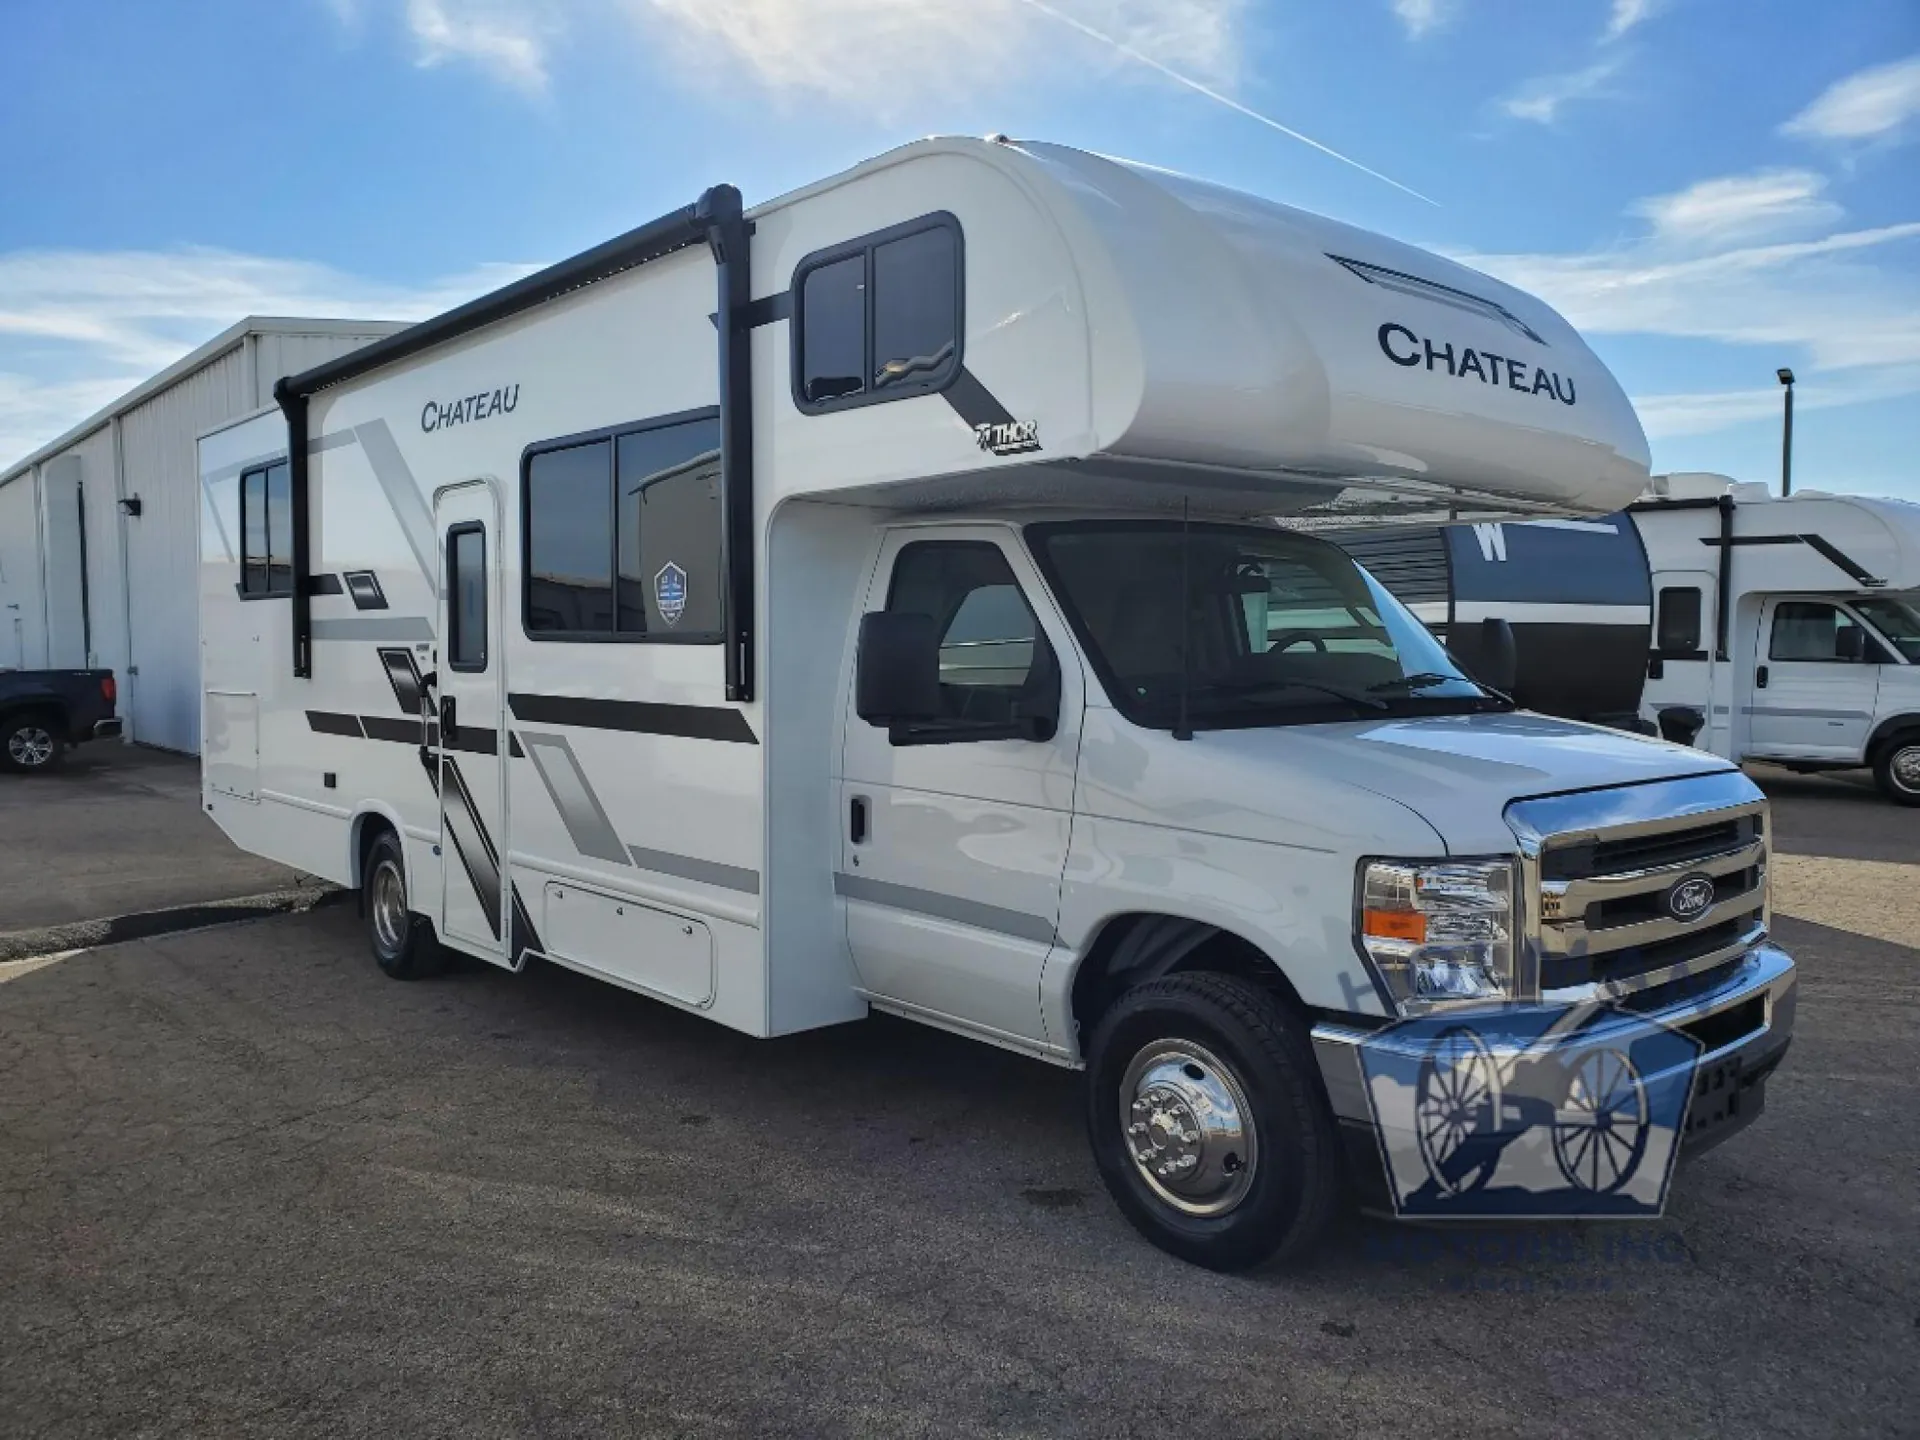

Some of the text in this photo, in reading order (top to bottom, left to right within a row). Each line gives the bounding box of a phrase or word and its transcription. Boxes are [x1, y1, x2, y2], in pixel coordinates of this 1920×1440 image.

[1377, 322, 1577, 406] CHATEAU
[421, 384, 520, 433] CHATEAU
[991, 419, 1038, 445] THOR
